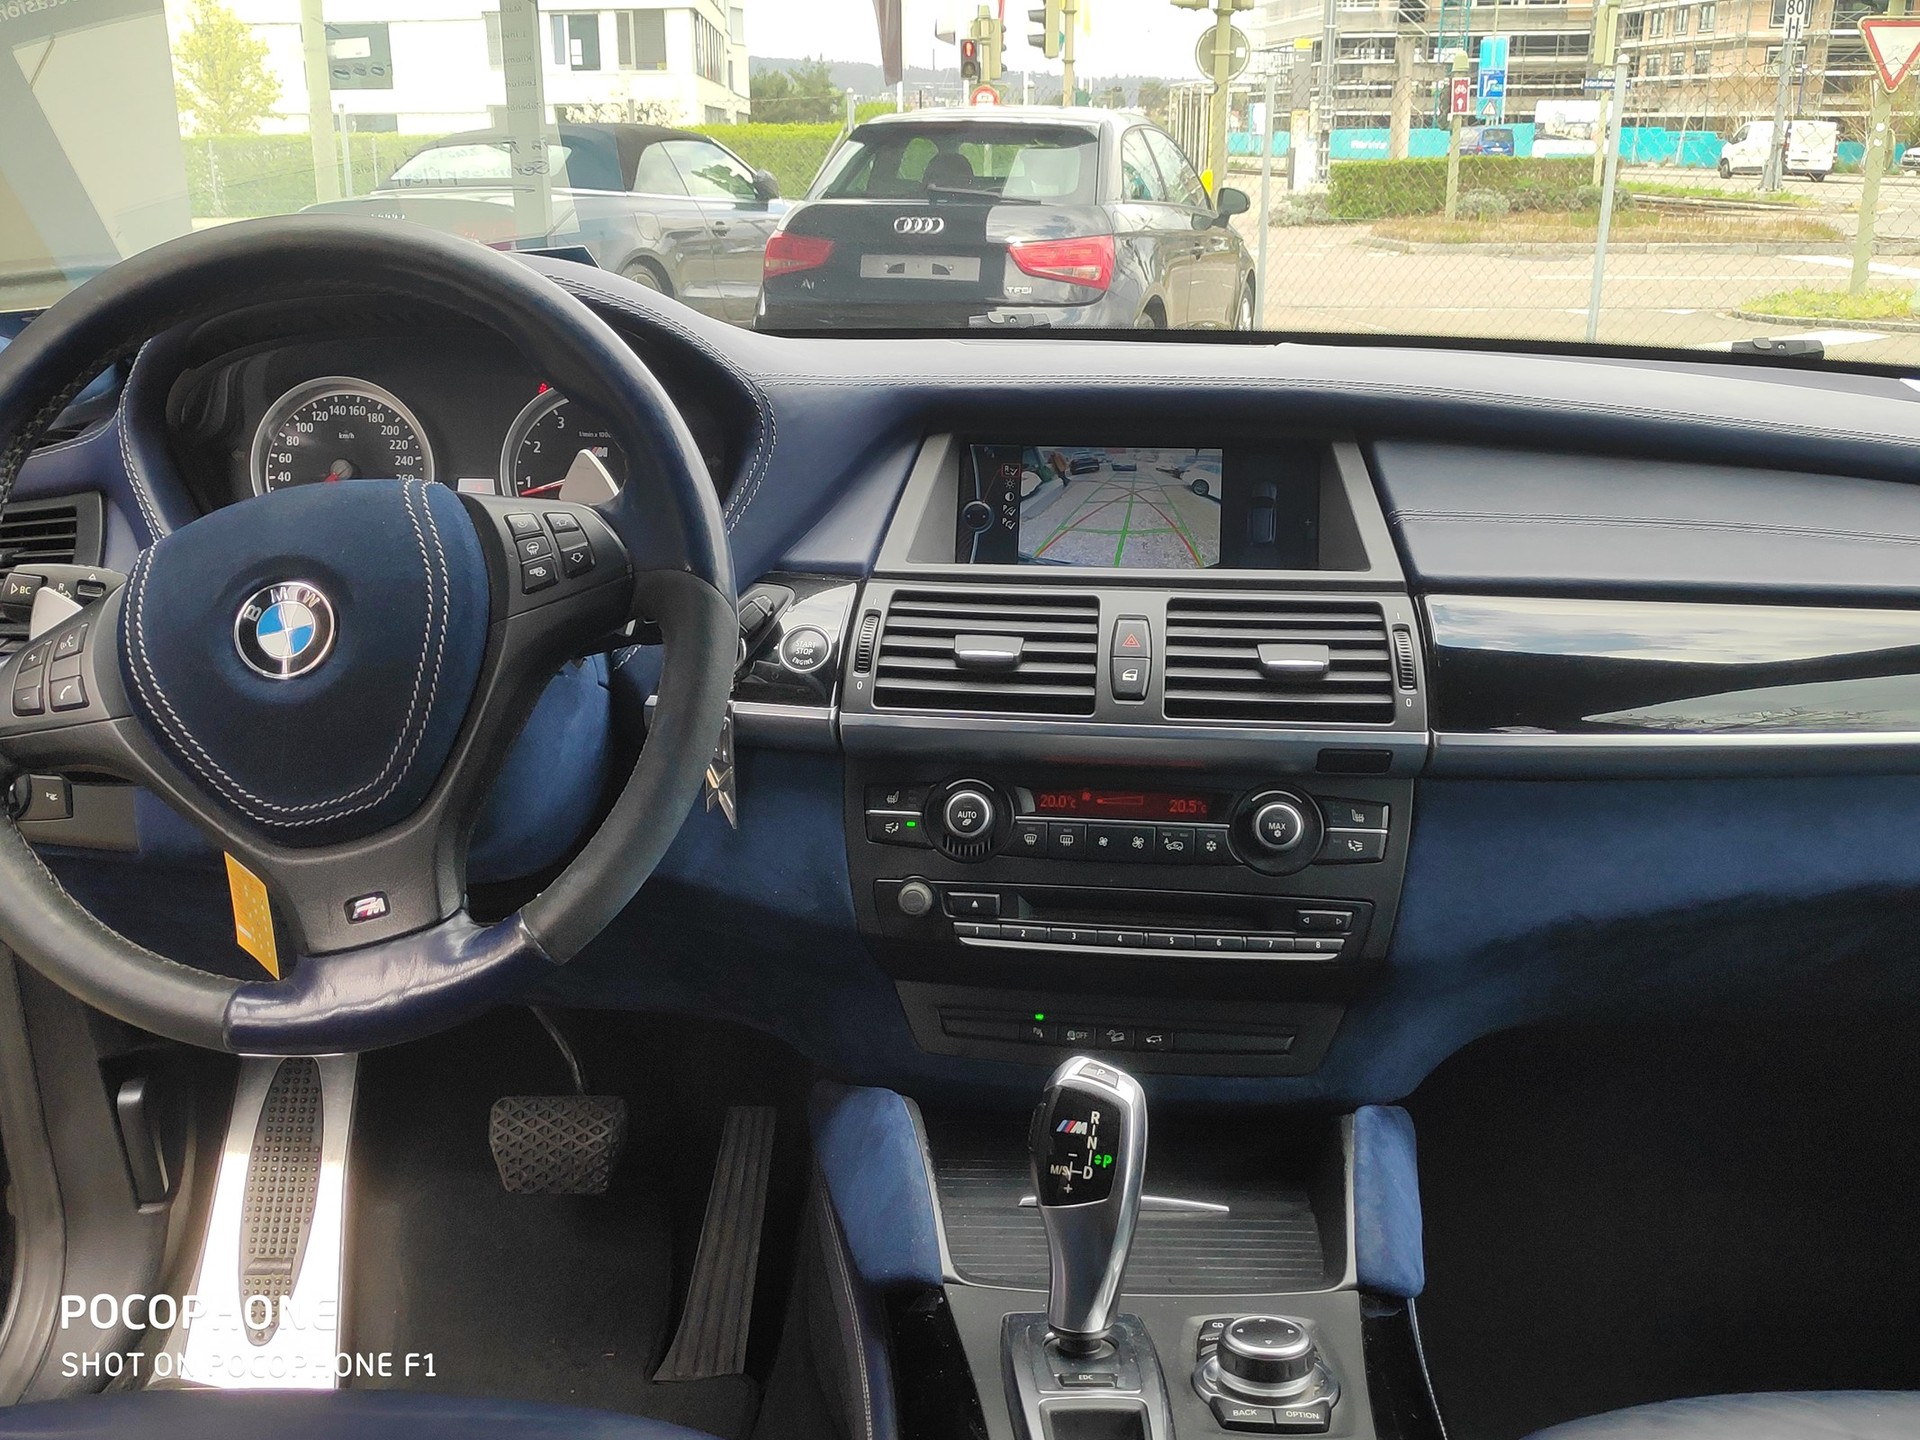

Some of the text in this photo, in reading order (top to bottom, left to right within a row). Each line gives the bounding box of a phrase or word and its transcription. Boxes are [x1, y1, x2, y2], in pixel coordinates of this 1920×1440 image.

[1787, 0, 1804, 15] 80
[329, 405, 347, 416] 140
[349, 405, 366, 416] 160
[312, 411, 329, 422] 120
[367, 413, 385, 424] 180
[296, 422, 314, 433] 100
[557, 416, 565, 429] 3
[338, 432, 355, 440] km/h
[380, 425, 400, 436] 200
[286, 435, 300, 447] 80
[389, 439, 409, 450] 220
[533, 441, 541, 453] 2
[278, 453, 292, 464] 60
[394, 455, 414, 466] 240
[277, 471, 291, 482] 40
[525, 476, 531, 488] 1
[20, 586, 31, 594] BC
[243, 586, 320, 622] BMW
[795, 640, 816, 648] START
[795, 647, 814, 655] STOP
[792, 657, 814, 665] ENGINE
[1268, 822, 1286, 831] MAX
[975, 926, 979, 935] 1
[1020, 929, 1026, 937] 2
[1071, 932, 1077, 940] 3
[1169, 936, 1175, 945] 5
[1216, 938, 1222, 946] 6
[1268, 940, 1274, 948] 7
[1315, 941, 1321, 949] 8
[1091, 1111, 1100, 1124] R
[1087, 1136, 1097, 1150] N
[1103, 1155, 1112, 1168] P
[1083, 1166, 1093, 1180] D
[1232, 1408, 1257, 1417] BACK
[1286, 1410, 1320, 1420] OPTION
